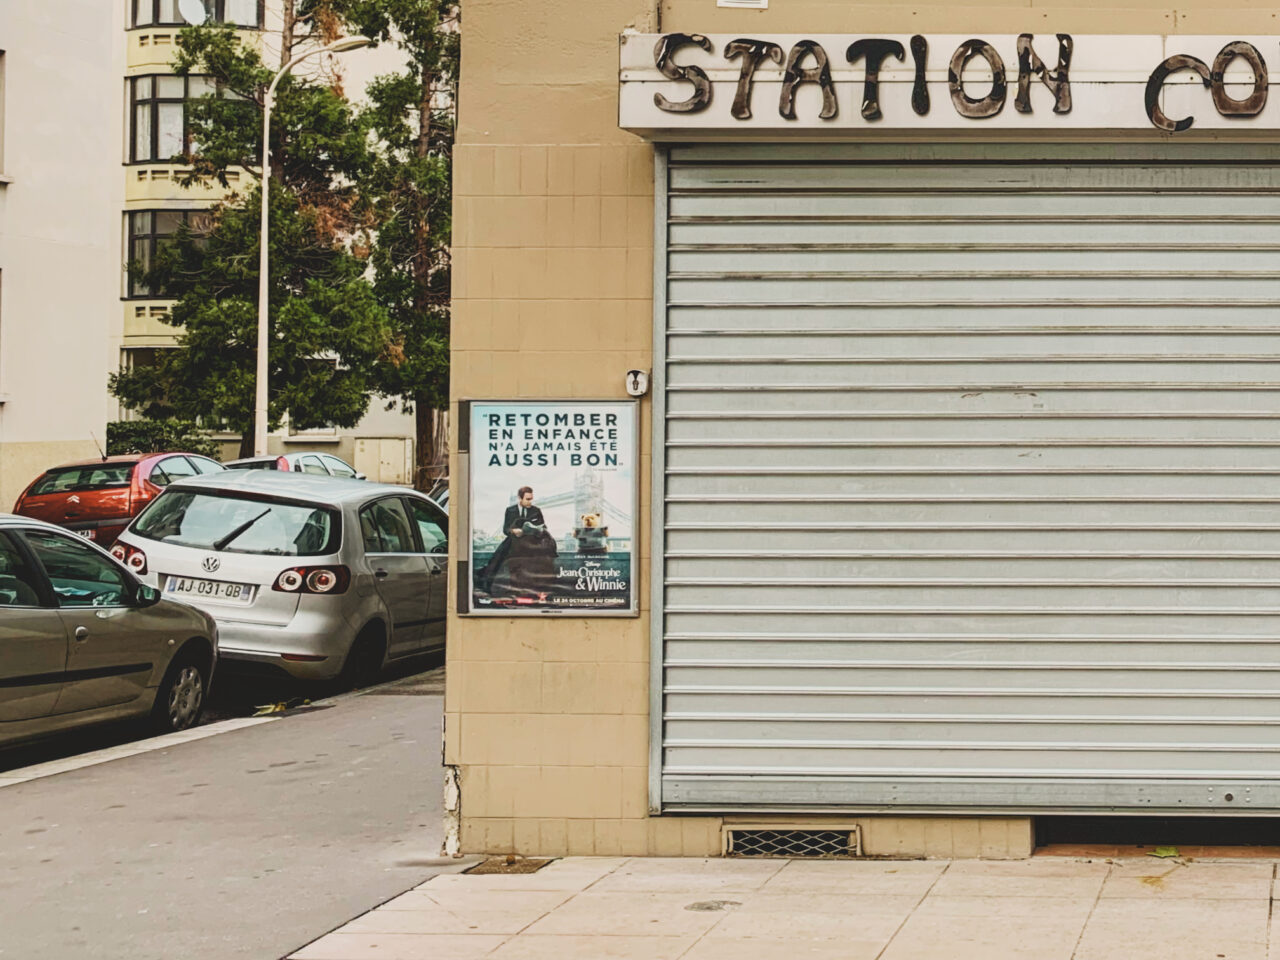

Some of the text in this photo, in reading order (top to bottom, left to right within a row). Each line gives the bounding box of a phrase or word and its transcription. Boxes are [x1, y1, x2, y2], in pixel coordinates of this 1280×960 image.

[653, 32, 1073, 120] STATION
[489, 429, 617, 440] EN ENFANCE
[523, 442, 582, 451] JAMAIS
[590, 439, 617, 451] ÉTÉ
[488, 453, 557, 466] AUSSI
[575, 577, 626, 591] & Winnie
